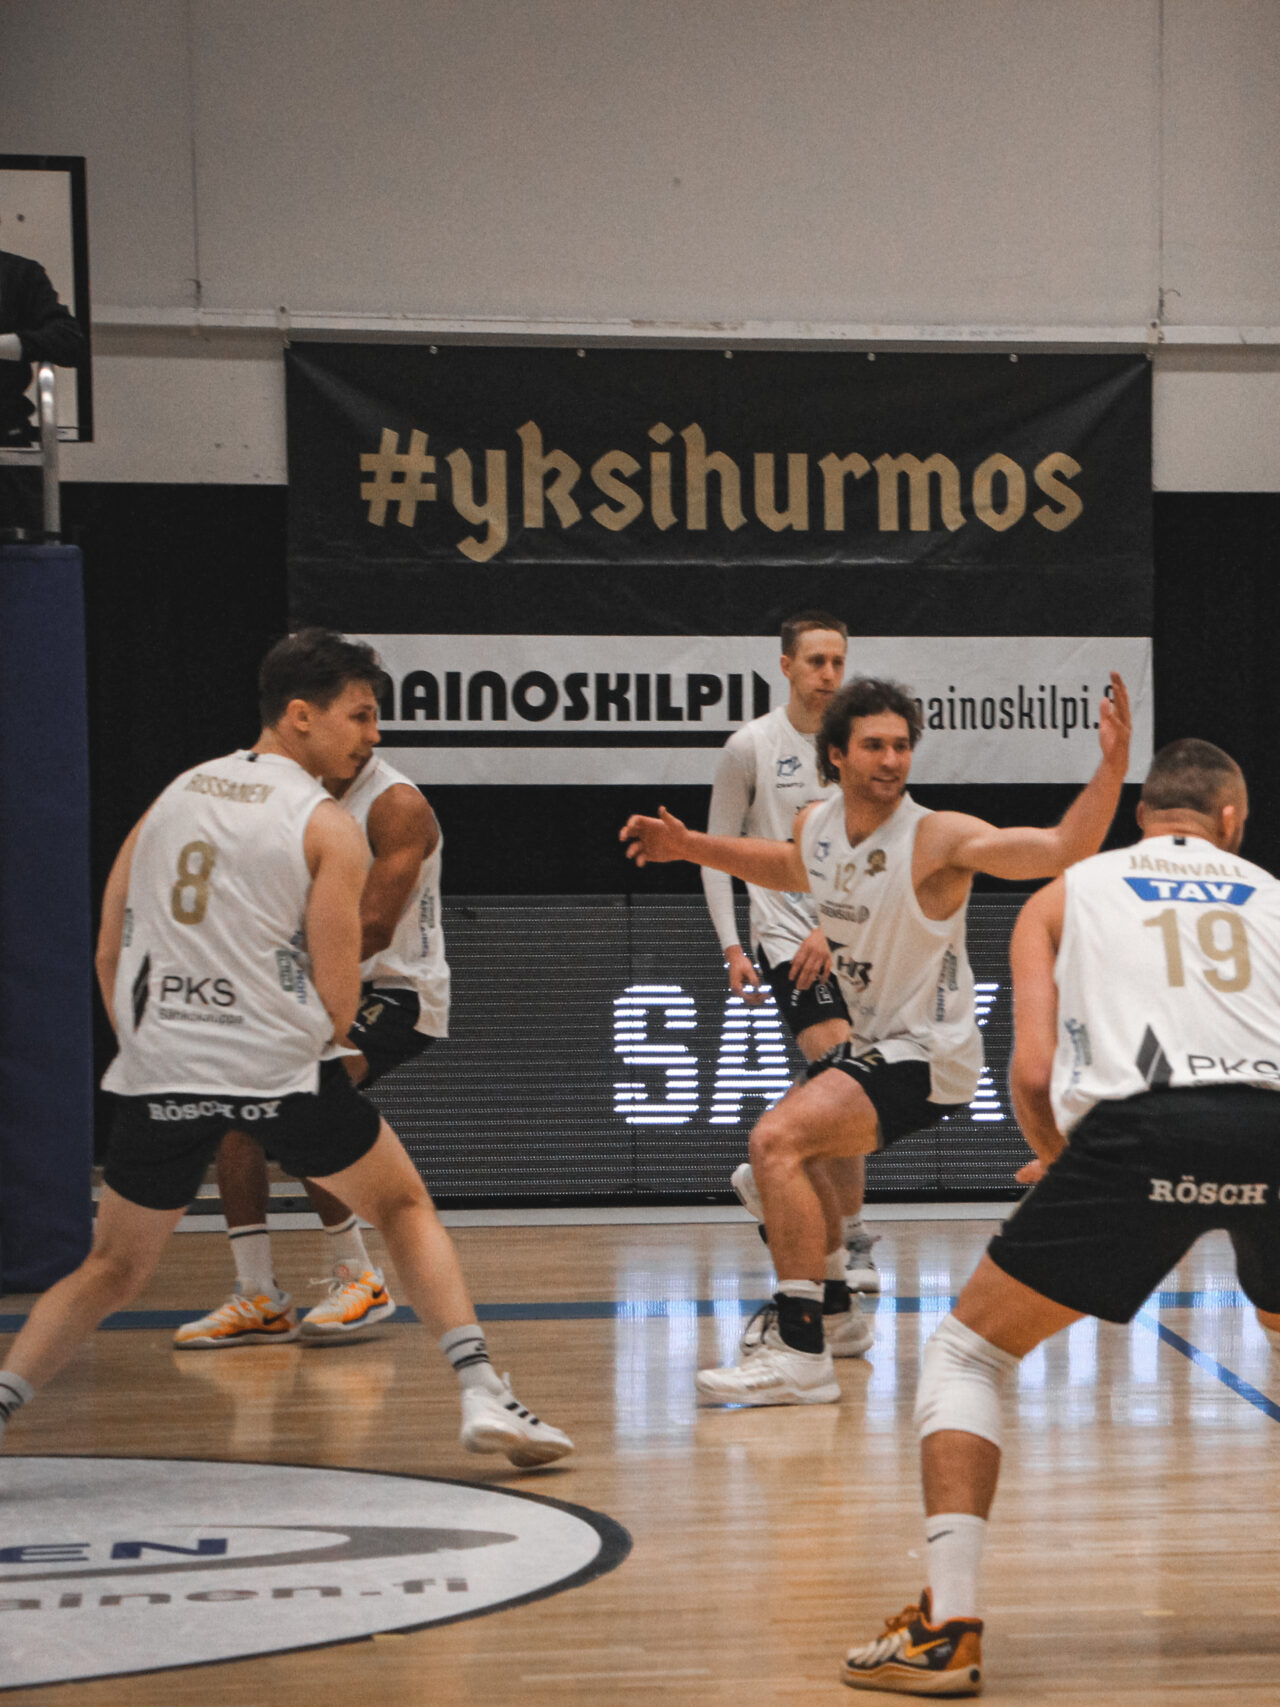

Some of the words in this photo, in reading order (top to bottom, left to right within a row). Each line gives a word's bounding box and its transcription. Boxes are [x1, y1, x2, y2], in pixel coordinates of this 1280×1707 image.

[359, 420, 1084, 563] #yksihurmos
[833, 862, 857, 893] 12
[1128, 855, 1248, 879] JÄRNVALL
[171, 840, 217, 926] 8
[1149, 880, 1234, 901] TAV
[1143, 907, 1252, 994] 19
[160, 976, 236, 1007] PKS
[241, 1100, 281, 1120] OY
[1149, 1175, 1269, 1205] RÖSCH
